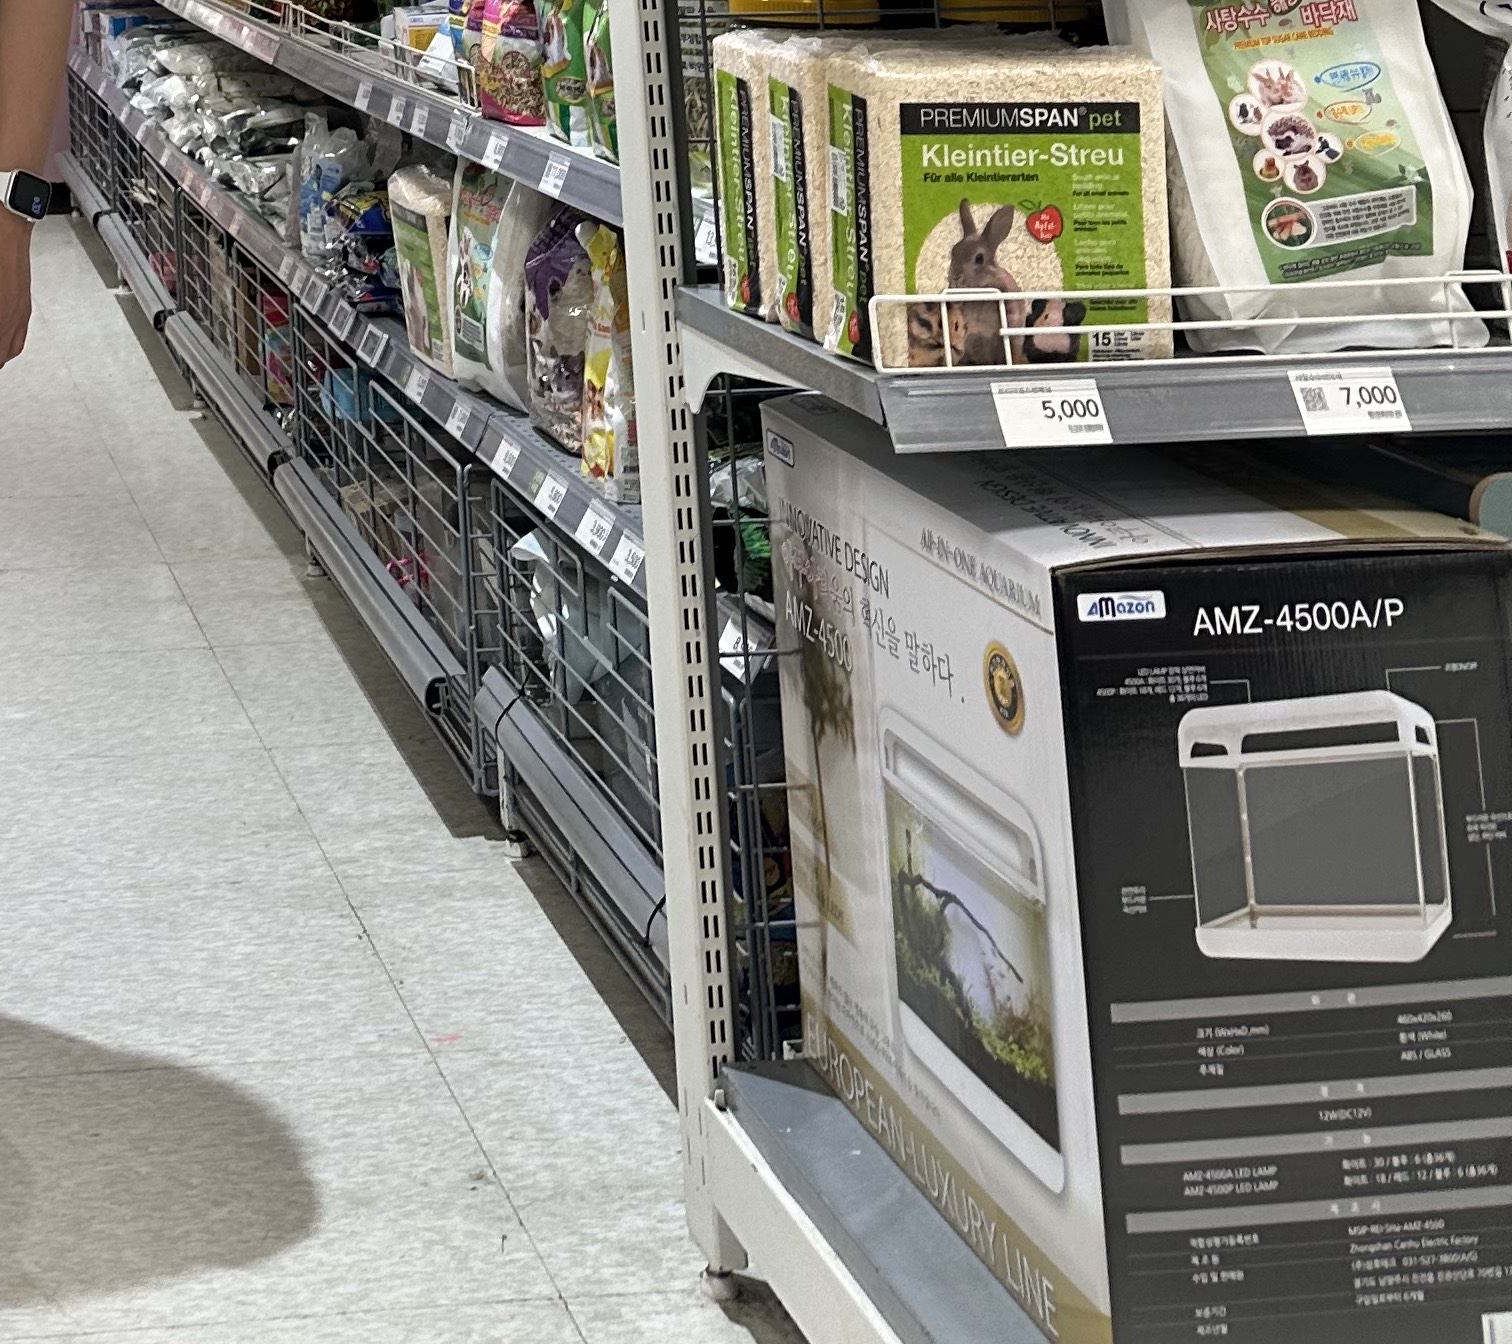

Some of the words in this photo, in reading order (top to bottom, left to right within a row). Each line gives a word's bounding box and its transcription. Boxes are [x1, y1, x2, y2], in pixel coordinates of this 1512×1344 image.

[1204, 4, 1272, 34] 사탕수수
[920, 108, 1079, 128] PREMIUMSPAN
[1089, 111, 1122, 130] pet
[922, 143, 1124, 167] Kleintier-Streu
[923, 172, 941, 182] Für
[944, 172, 964, 183] alle
[966, 172, 1039, 183] Kleintierarten
[1092, 332, 1111, 347] 15
[1041, 398, 1099, 422] 5,000
[1339, 386, 1397, 408] 7,000
[844, 543, 890, 599] DESIGN
[979, 564, 1041, 617] AQUARIUM
[1193, 598, 1405, 636] AMZ-4500A/P
[784, 589, 853, 673] AMZ-4500
[1002, 1233, 1060, 1338] LINE
